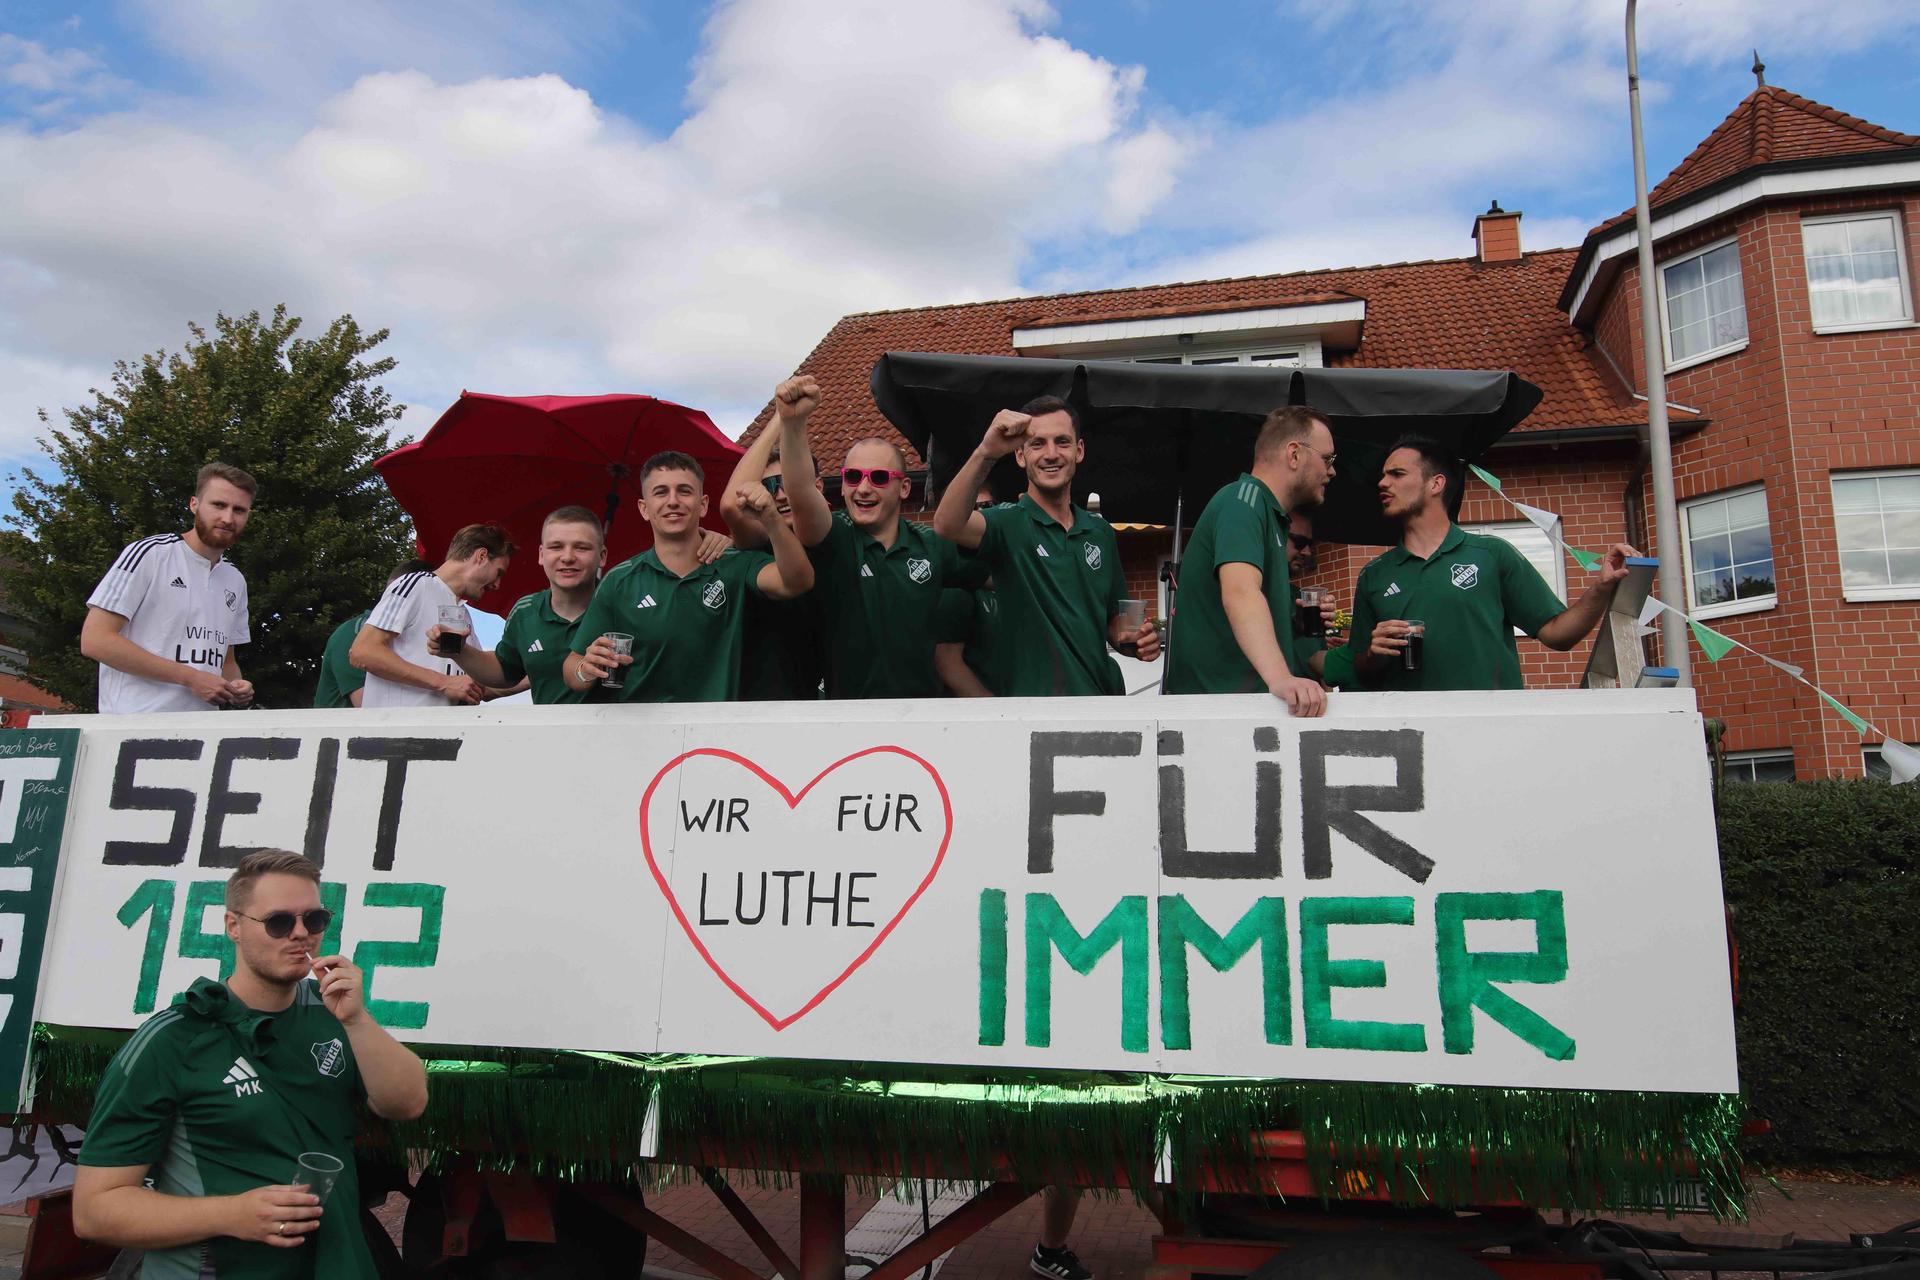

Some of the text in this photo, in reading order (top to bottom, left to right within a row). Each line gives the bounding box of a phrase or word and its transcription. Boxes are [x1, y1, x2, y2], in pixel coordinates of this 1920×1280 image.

[1455, 566, 1475, 584] LUTHE
[705, 582, 722, 603] LUTHE
[186, 625, 212, 640] Wir
[175, 644, 224, 668] Luth
[102, 736, 463, 871] SEIT
[681, 793, 922, 832] WIR FÜR
[1027, 726, 1436, 885] FÜR
[699, 871, 878, 928] LUTHE
[978, 887, 1576, 1062] IMMER
[321, 1041, 341, 1073] LUTHE
[234, 1079, 265, 1098] MK
